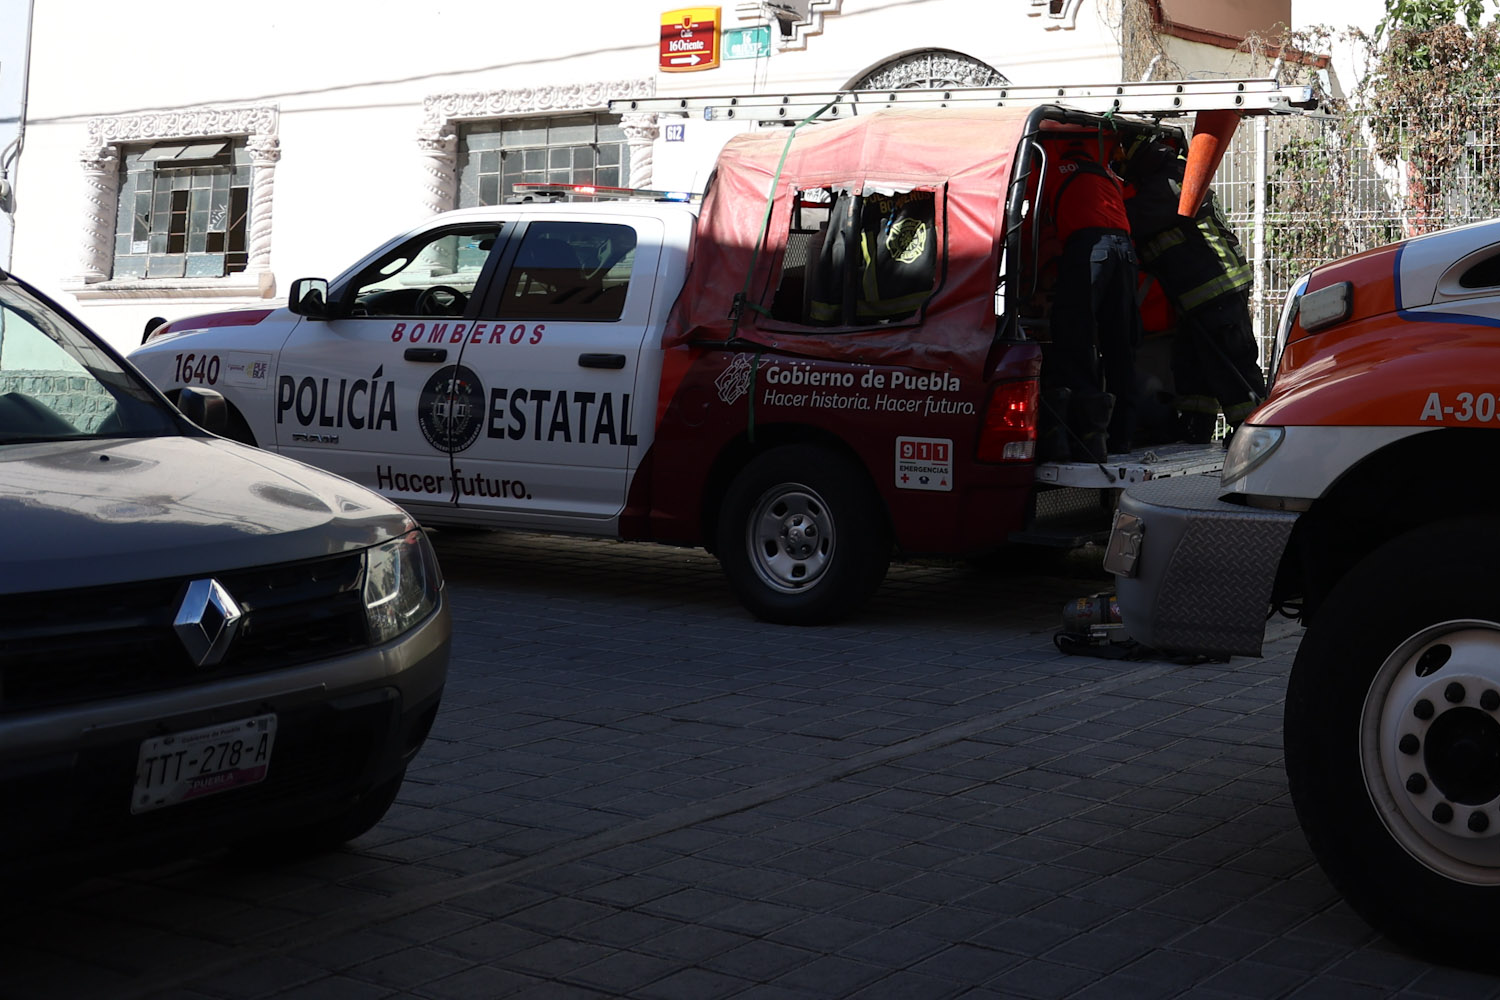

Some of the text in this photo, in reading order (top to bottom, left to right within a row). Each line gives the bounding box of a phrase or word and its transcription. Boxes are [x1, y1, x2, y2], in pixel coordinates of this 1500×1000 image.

[669, 39, 705, 52] 16 Oriente
[667, 126, 682, 140] 612
[391, 322, 547, 345] BOMBEROS
[175, 353, 221, 385] 1640
[766, 365, 961, 392] Gobierno de Puebla
[276, 363, 639, 446] POLICÍA ESTATAL
[763, 388, 977, 418] Hacer historia. Hacer futuro.
[292, 432, 339, 444] RAM
[903, 444, 945, 460] 911
[899, 465, 949, 474] EMERGENCIAS
[376, 463, 533, 502] Hacer futuro.
[145, 733, 268, 789] TTT-278-A
[192, 772, 235, 790] PUEBLA
